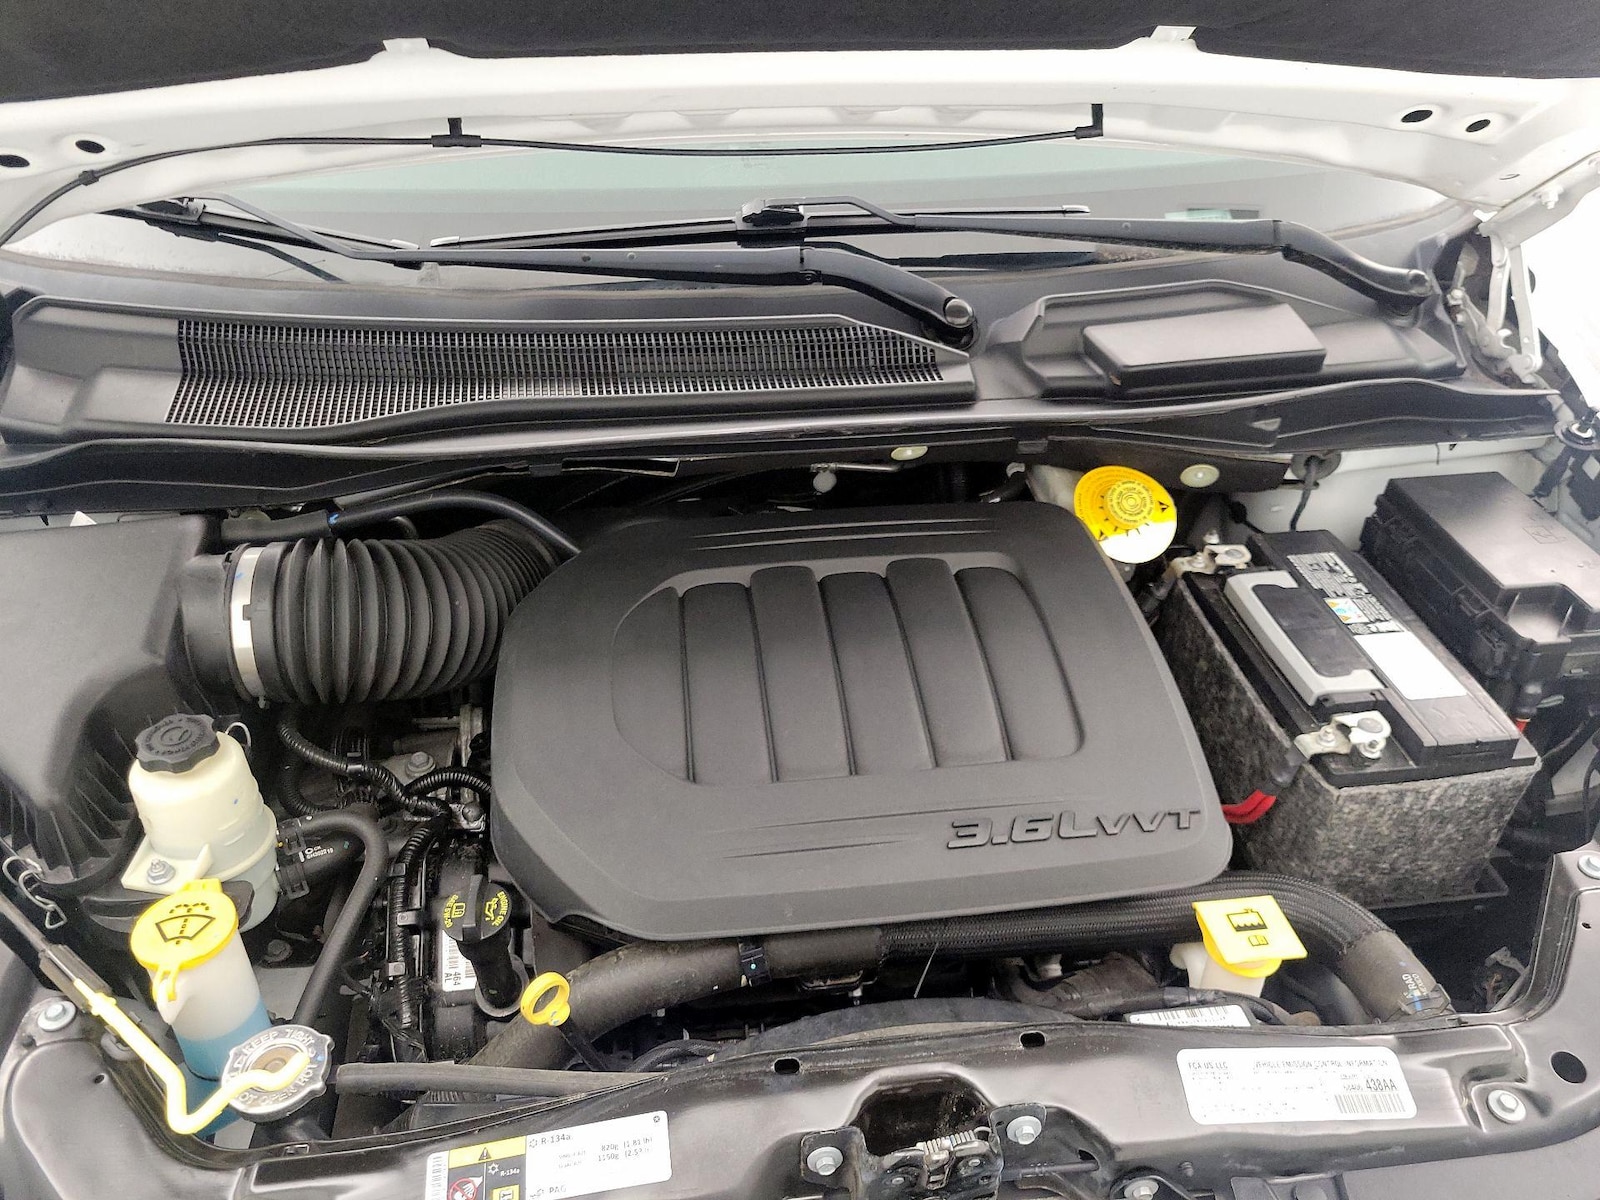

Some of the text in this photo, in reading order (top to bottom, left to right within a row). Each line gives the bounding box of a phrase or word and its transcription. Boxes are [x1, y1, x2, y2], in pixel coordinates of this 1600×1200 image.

[492, 891, 509, 926] ENGINE OIL
[244, 1028, 315, 1055] KEEP TIGHT
[1188, 1062, 1202, 1070] FCA
[1203, 1062, 1214, 1070] US
[1254, 1061, 1280, 1069] VEHICLE
[1281, 1060, 1313, 1069] EMISSION
[1345, 1059, 1388, 1067] INFORMATION
[260, 1086, 297, 1105] OPEN
[299, 1063, 318, 1086] HOT
[1365, 1078, 1397, 1091] 438AA
[541, 1133, 571, 1145] R-134a
